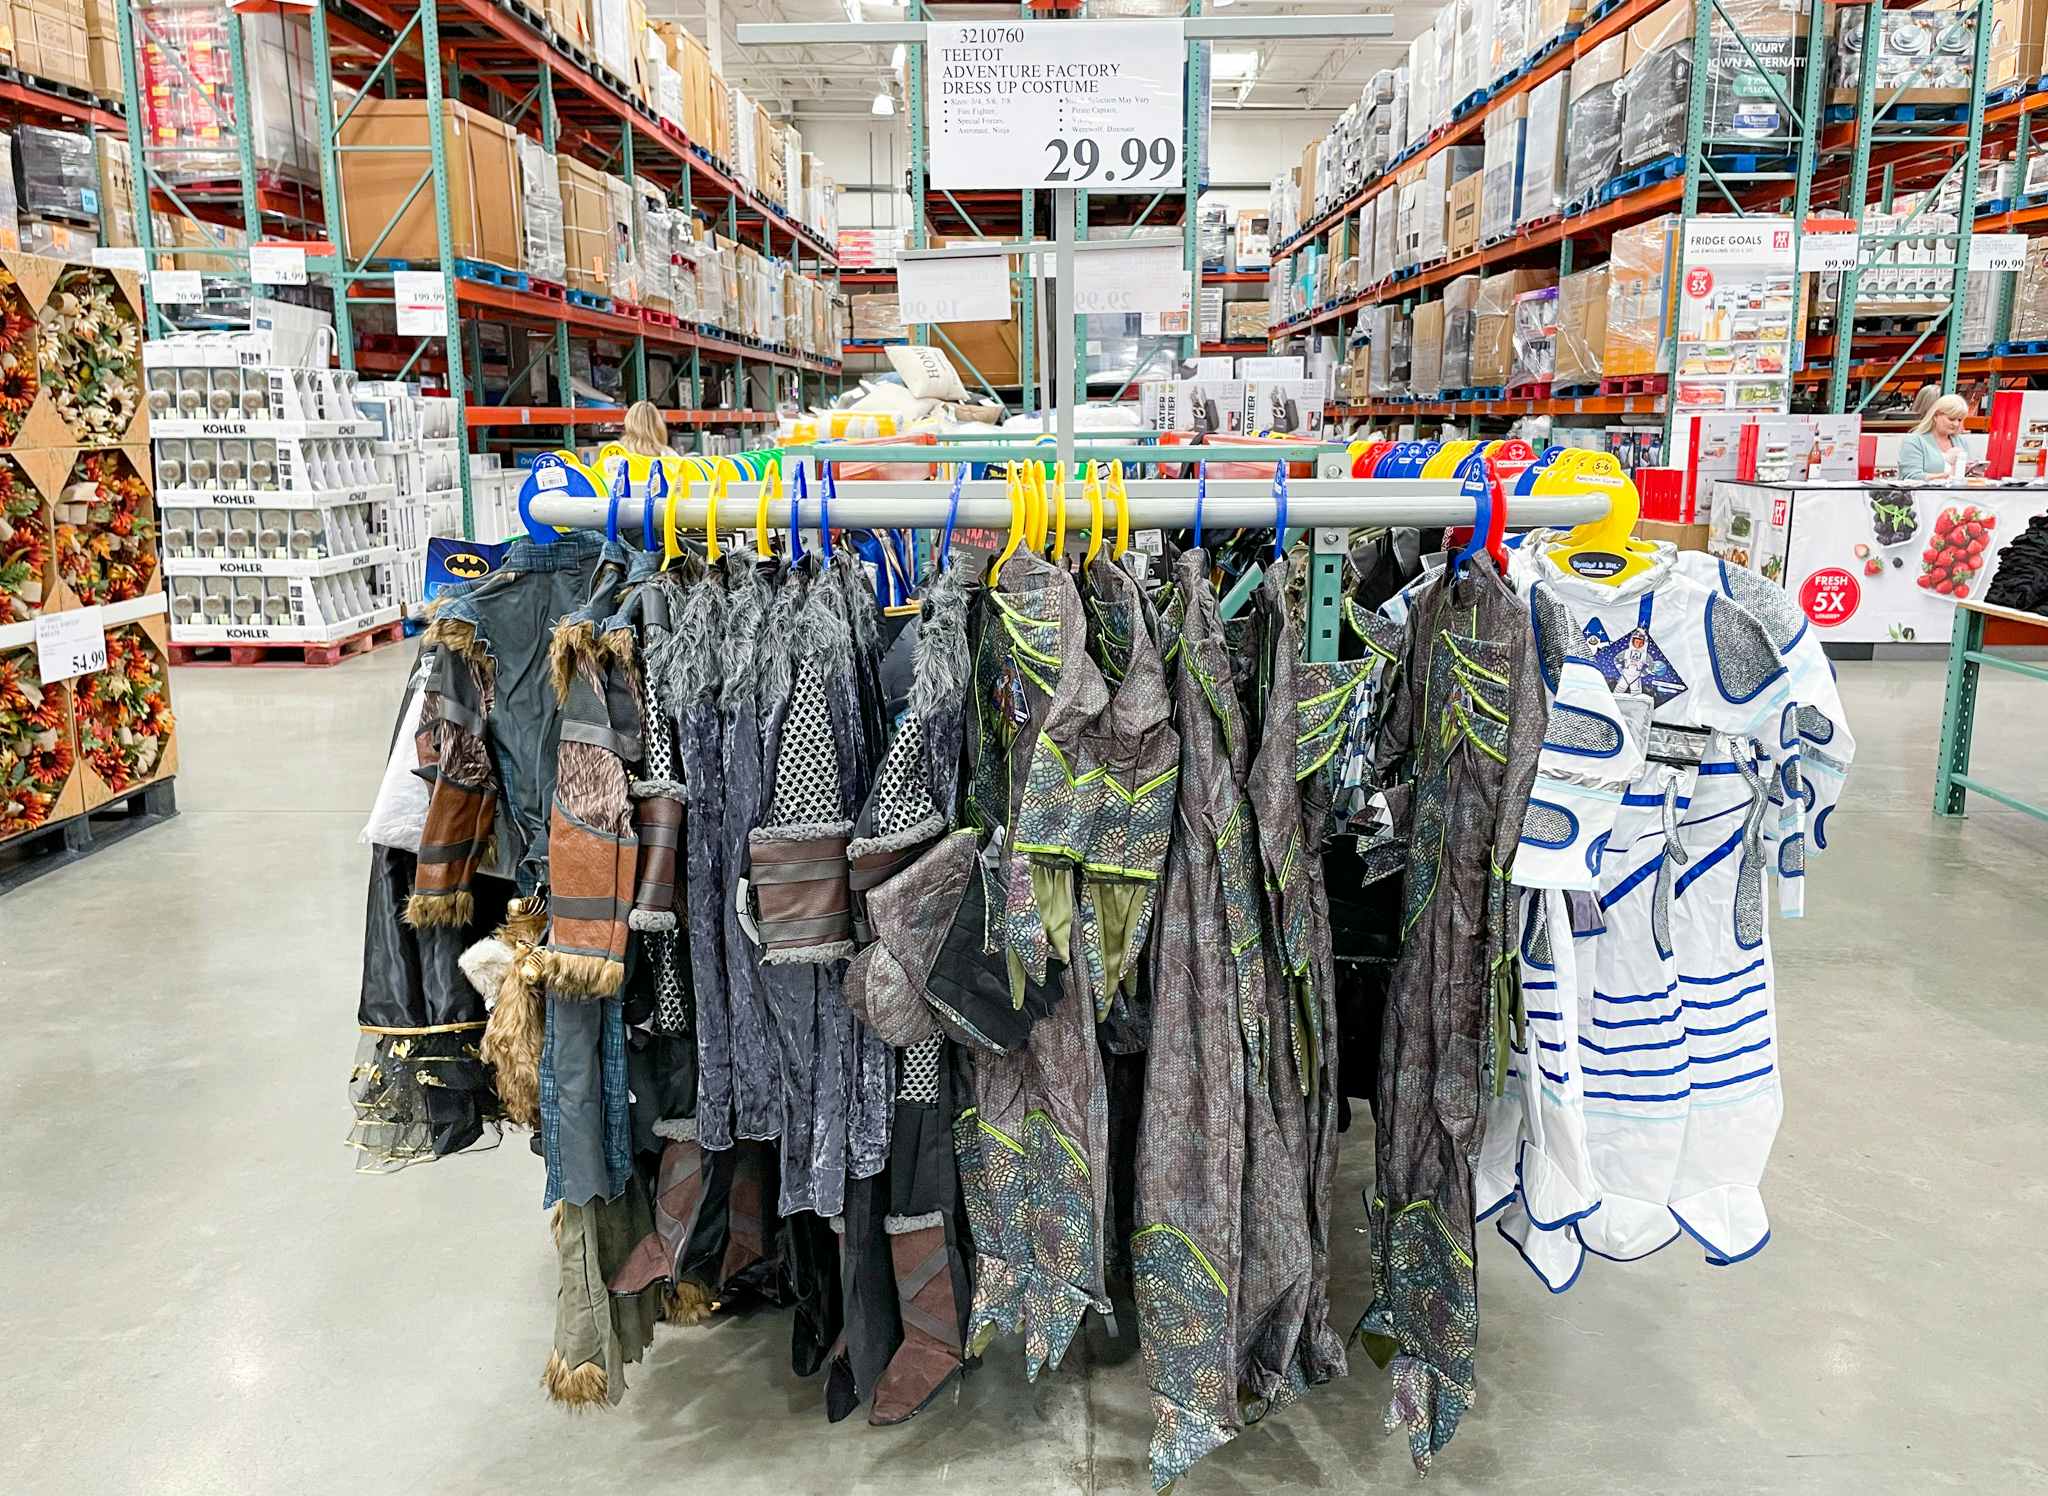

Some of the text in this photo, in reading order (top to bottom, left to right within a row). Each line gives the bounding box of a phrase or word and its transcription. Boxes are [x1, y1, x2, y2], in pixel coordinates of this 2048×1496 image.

[959, 28, 1024, 43] 3210760
[942, 48, 1003, 62] TEETOT
[942, 63, 1121, 79] ADVENTURE FACTORY
[943, 80, 1099, 95] DRESS UP COSTUME
[1043, 137, 1176, 182] 29.99
[1690, 236, 1762, 245] FRIDGE GOALS
[1825, 259, 1856, 269] 99.99
[1988, 259, 2025, 270] 199.99
[1691, 280, 1707, 292] 5X
[203, 424, 247, 434] KOHLER
[1595, 462, 1610, 470] 5-6
[213, 494, 256, 505] KOHLER
[220, 563, 263, 573] KOHLER
[1815, 575, 1849, 587] FRESH
[1812, 591, 1846, 612] 5X
[226, 629, 270, 639] KOHLER
[73, 650, 104, 674] 54.99
